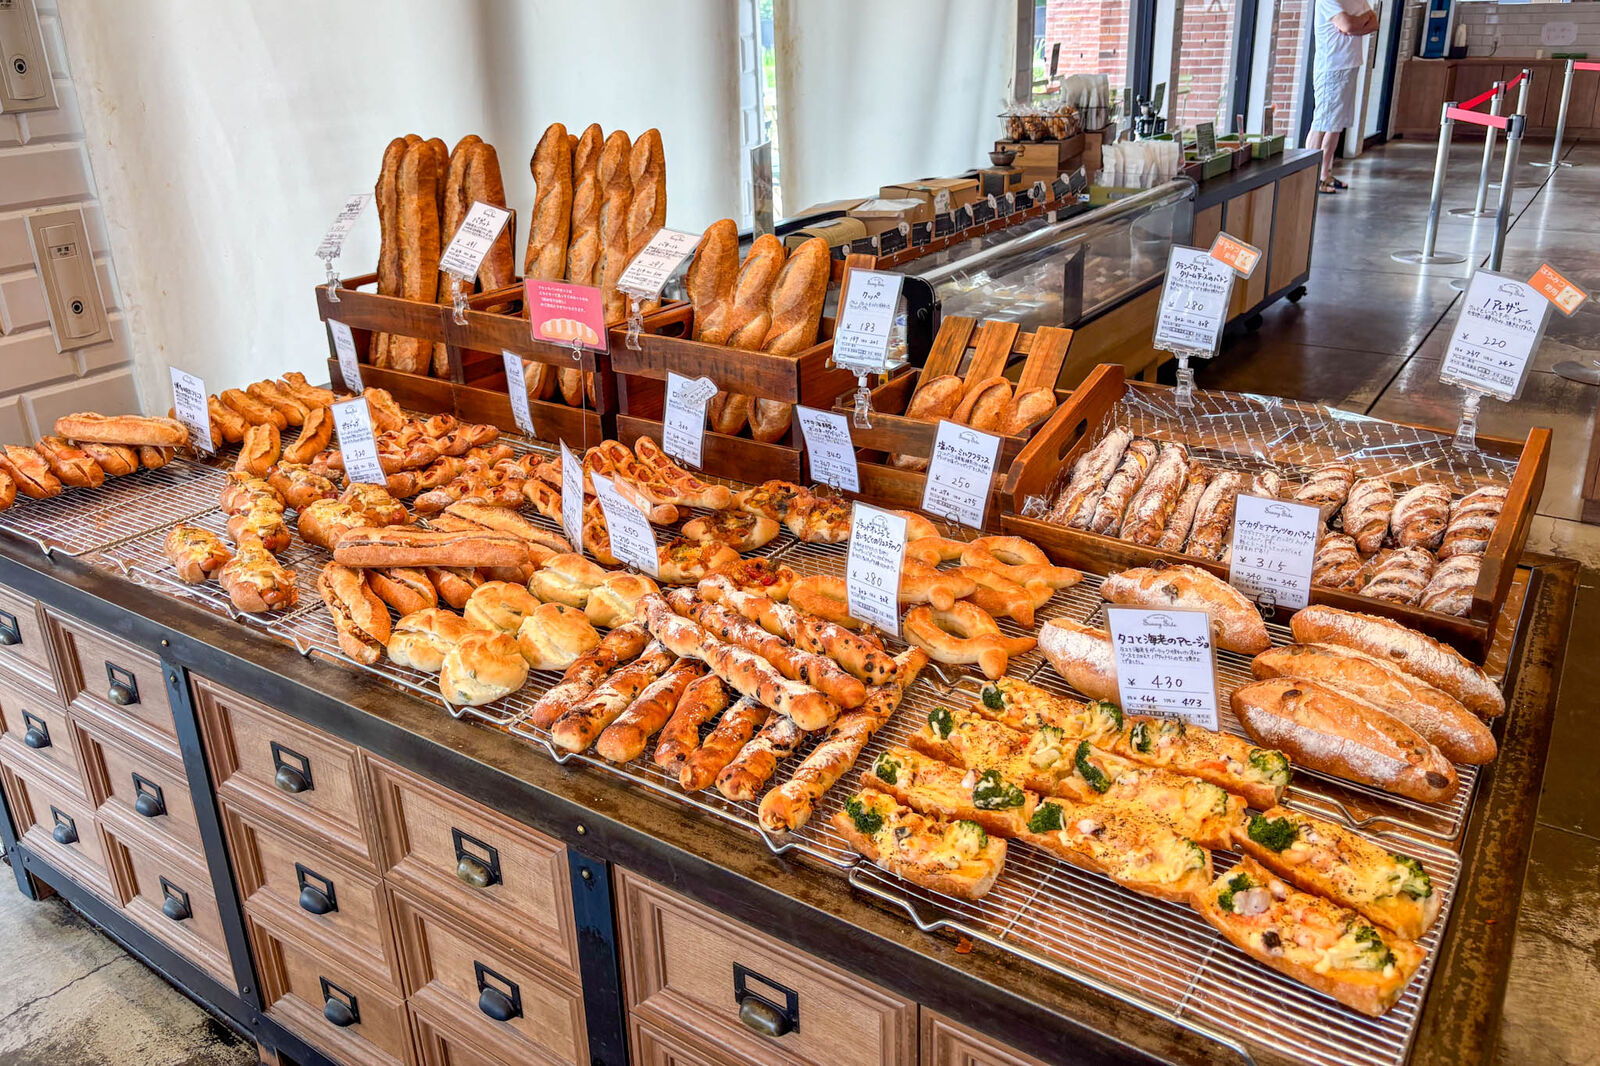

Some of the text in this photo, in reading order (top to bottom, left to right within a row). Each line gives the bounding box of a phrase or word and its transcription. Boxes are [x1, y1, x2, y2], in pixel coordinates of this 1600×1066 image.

[1175, 261, 1207, 272] クランベリーと
[1540, 267, 1566, 288] はちみつ
[862, 291, 881, 299] クッペ
[1184, 300, 1204, 311] 280
[1483, 298, 1528, 315] ノアレザン
[860, 322, 876, 332] 183
[1462, 332, 1507, 348] ¥ 220
[1466, 349, 1481, 358] 237
[951, 476, 970, 489] 250
[963, 497, 978, 507] 275
[1264, 507, 1281, 518] Sunny
[623, 525, 639, 538] 250
[1237, 520, 1315, 541] マカダミアナッツのバゲット
[1256, 557, 1287, 572] 315
[864, 572, 883, 587] 280
[1246, 572, 1262, 580] 340
[1281, 579, 1297, 588] 346
[1143, 618, 1177, 629] Sunny Side
[1118, 633, 1210, 649] タコと海老のアヒージョ
[1127, 675, 1183, 689] ¥ 430
[1140, 695, 1158, 703] 464
[1182, 698, 1202, 707] 473
